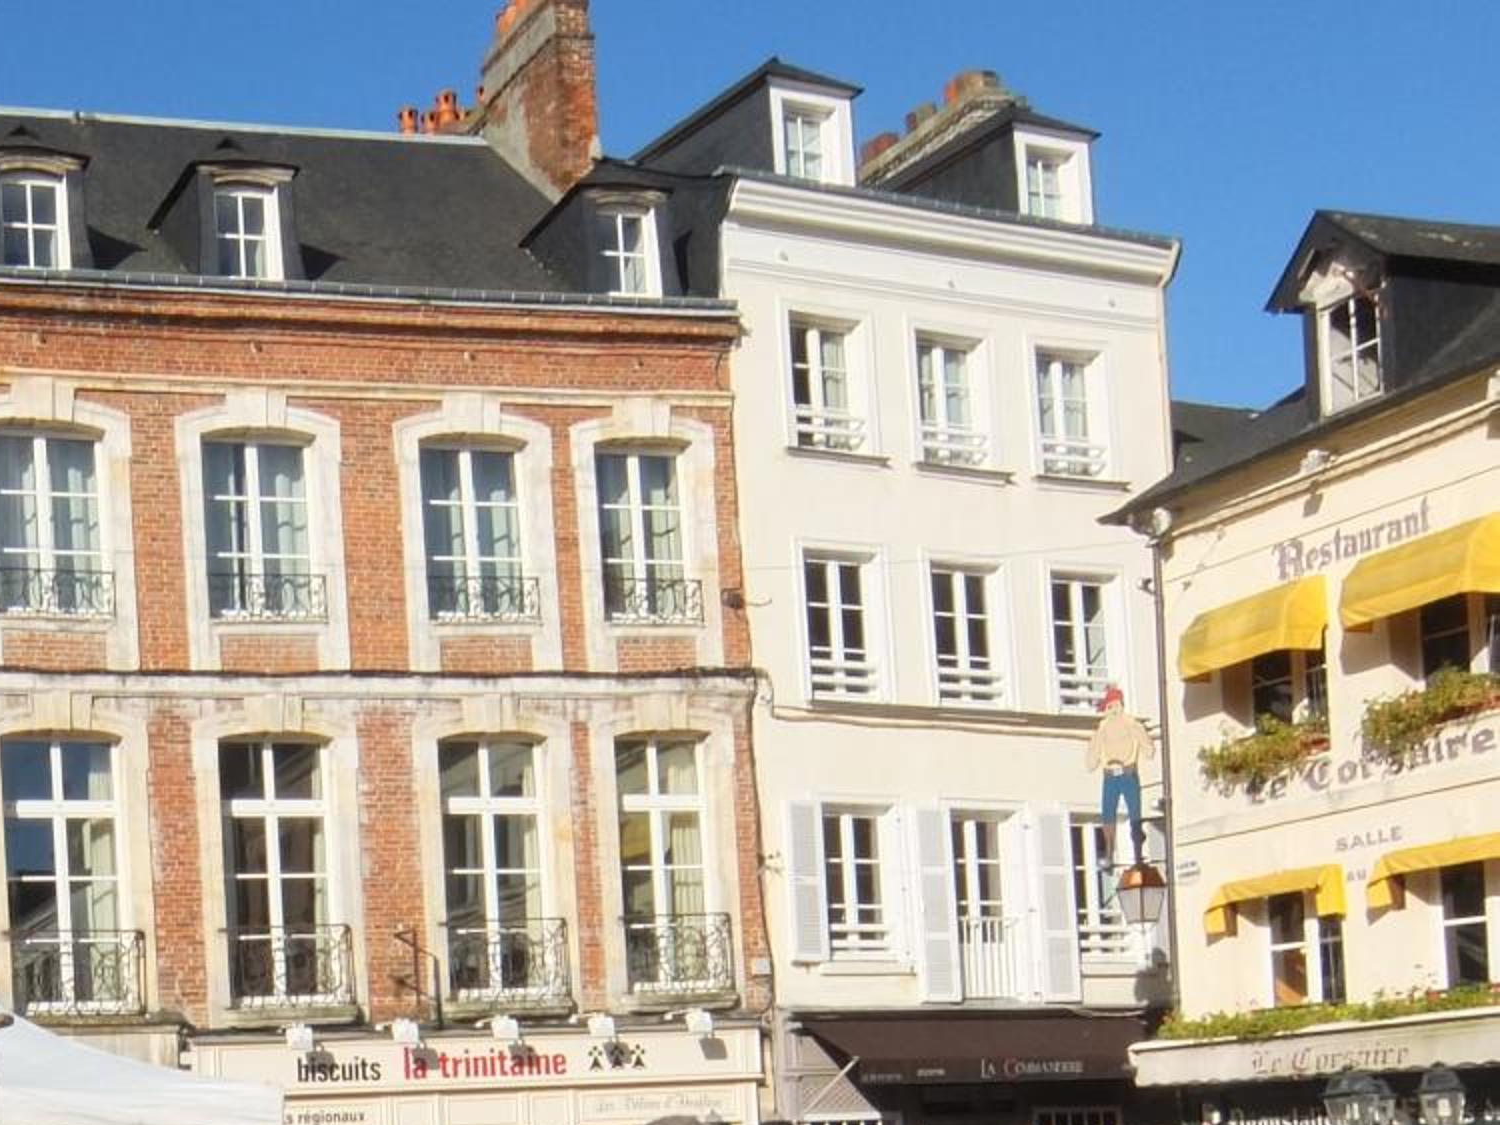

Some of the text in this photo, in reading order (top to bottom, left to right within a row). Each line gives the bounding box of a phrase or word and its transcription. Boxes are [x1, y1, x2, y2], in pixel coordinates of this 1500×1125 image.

[1271, 495, 1430, 580] Restaurant
[1334, 826, 1404, 852] SALLE
[297, 1046, 567, 1082] biscuits la trinitaine
[1290, 1043, 1410, 1073] Corsaire
